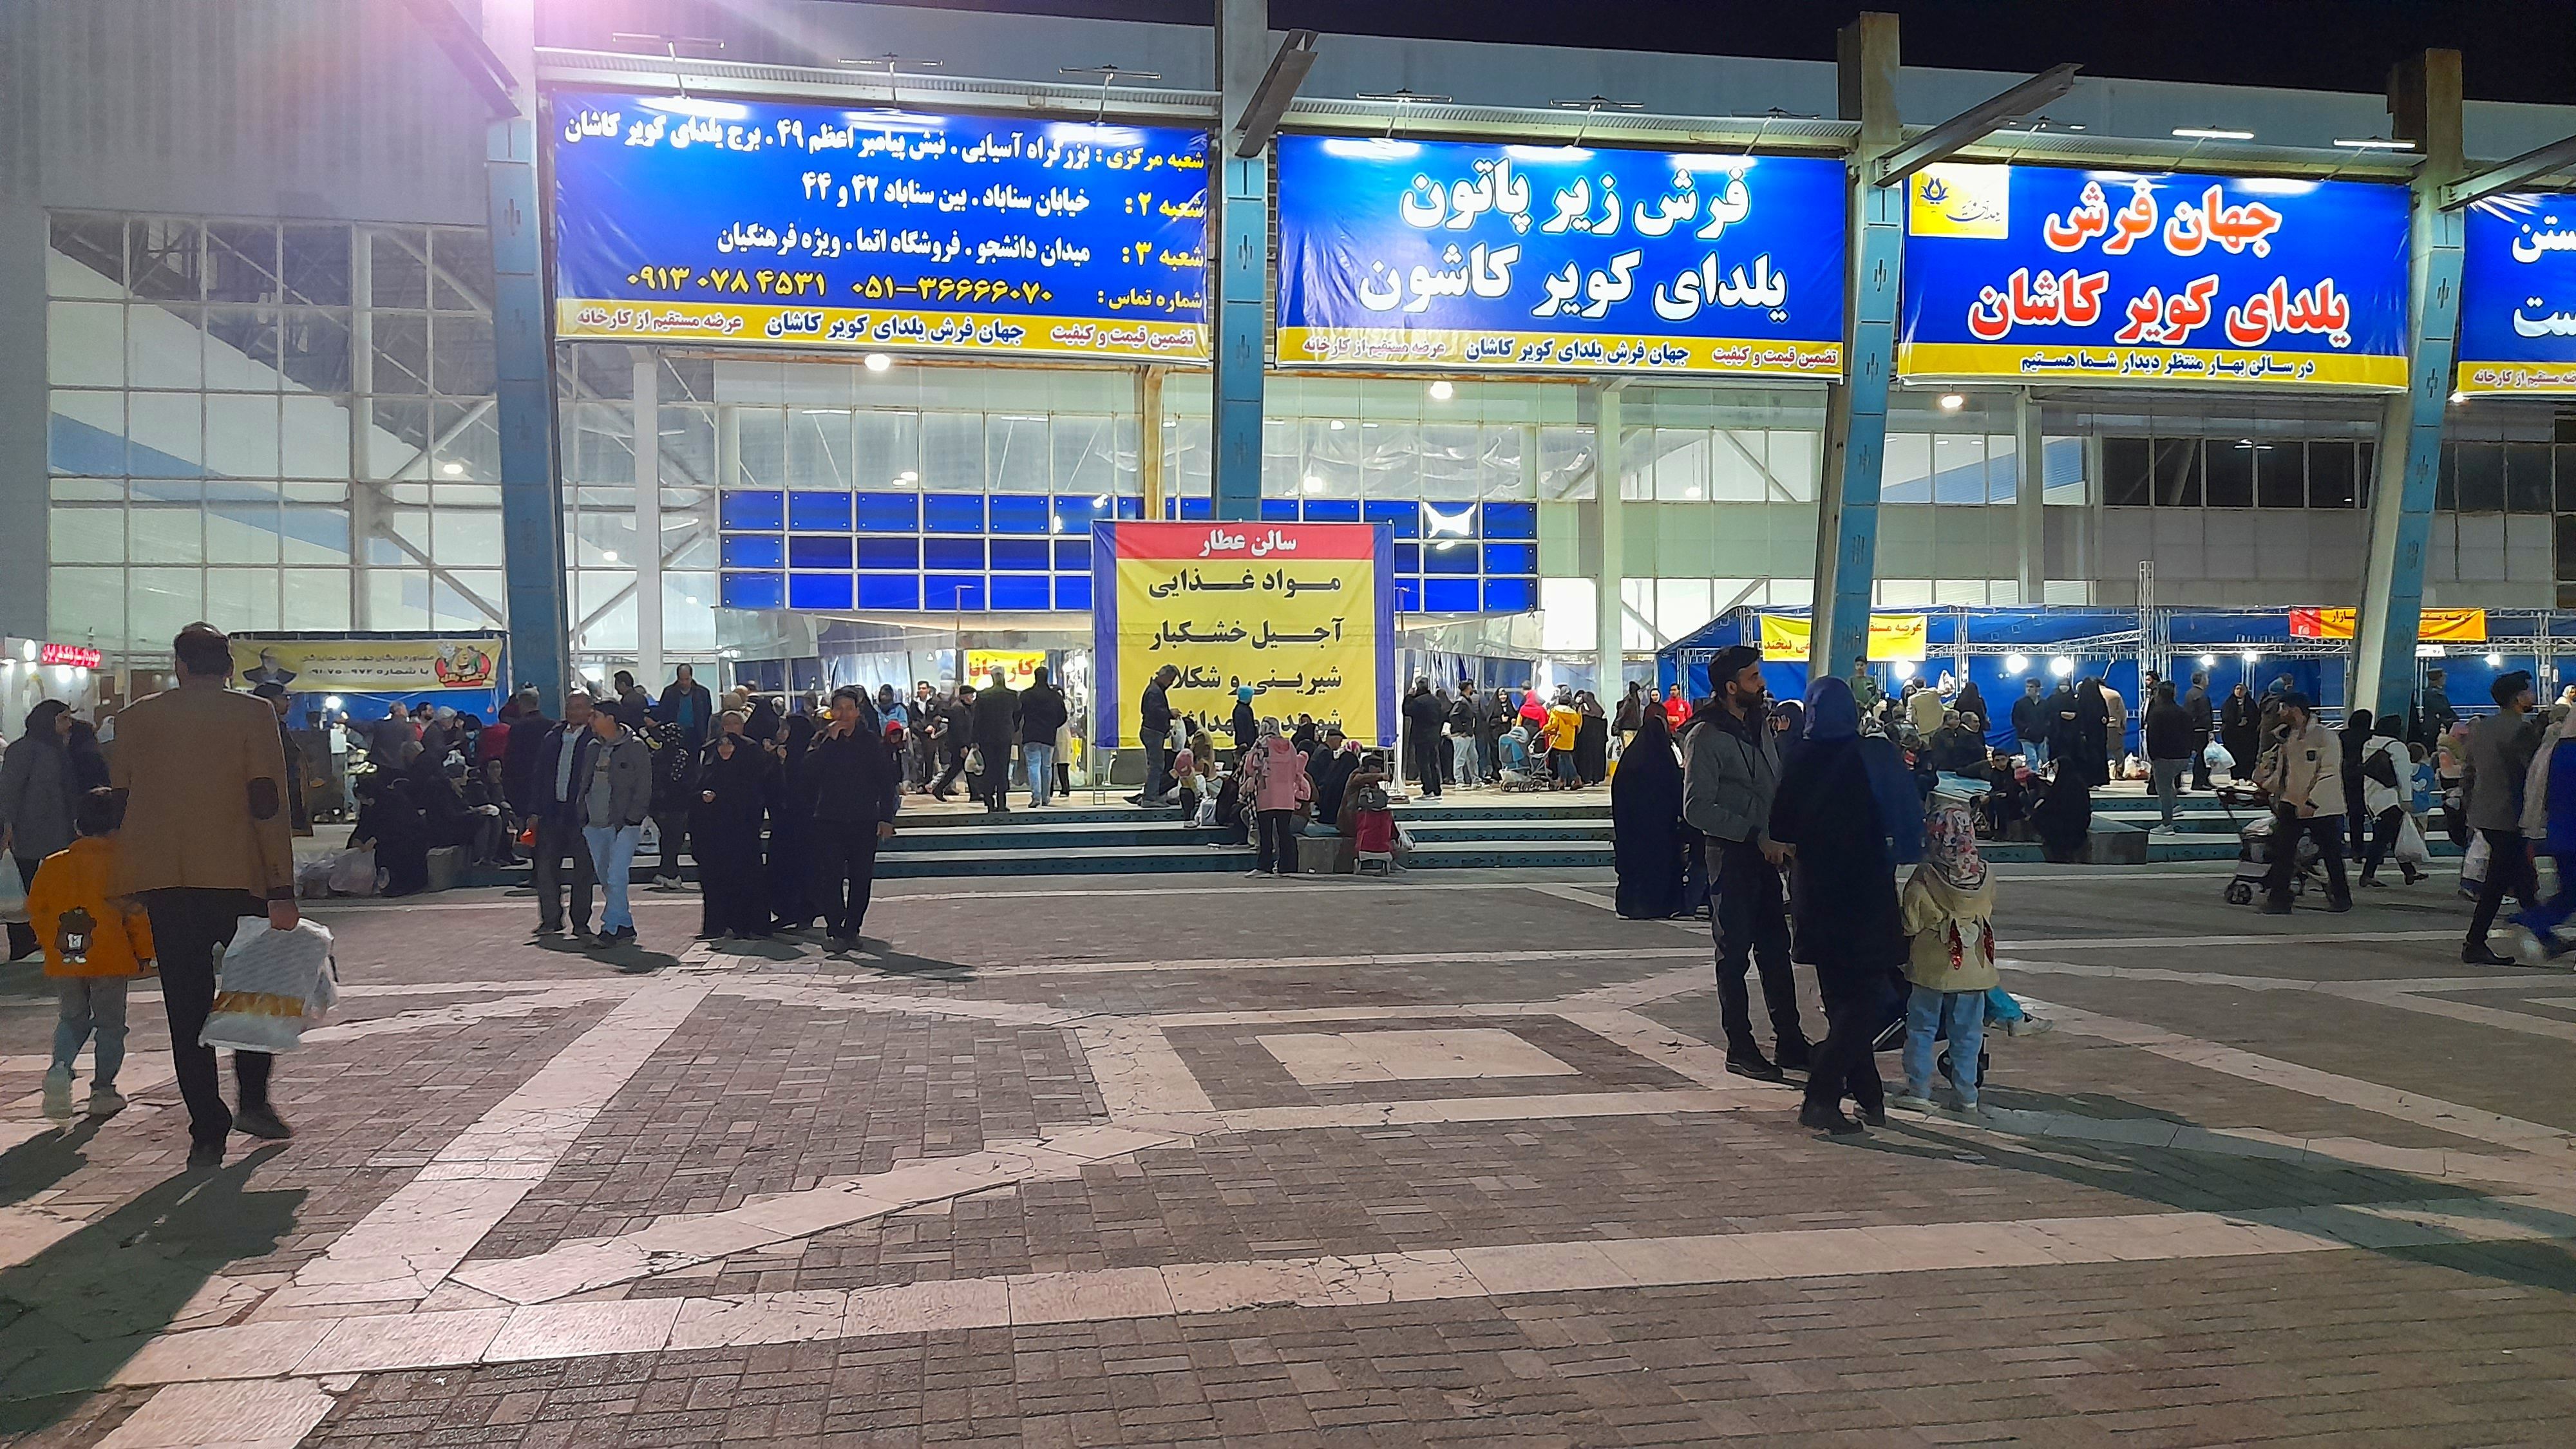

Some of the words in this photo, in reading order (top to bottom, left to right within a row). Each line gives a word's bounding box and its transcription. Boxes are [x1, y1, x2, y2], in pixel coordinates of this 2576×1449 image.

[565, 110, 621, 142] کاشان
[624, 114, 667, 147] کویر
[670, 115, 724, 149] یلدای
[726, 125, 761, 151] برج
[776, 118, 804, 148] ۴۹
[808, 123, 855, 155] اعظم
[858, 129, 905, 161] پیامبر
[909, 129, 946, 160] نبش
[961, 131, 1024, 163] آسیایی
[1026, 135, 1090, 170] بزرگراه
[1106, 147, 1163, 171] مرکزی
[1167, 151, 1205, 172] شعبه
[802, 171, 832, 200] ۴۴
[837, 185, 848, 207] و
[851, 174, 879, 203] ۴۲
[884, 178, 934, 209] سناباد
[1401, 158, 1531, 234] پاتون
[938, 189, 967, 213] بین
[982, 183, 1032, 214] سناباد
[1035, 186, 1090, 217] خیابان
[1138, 191, 1152, 216] ۲
[1159, 196, 1205, 222] شعبه
[1542, 173, 1622, 236] زیر
[1634, 166, 1751, 238] فرش
[2048, 180, 2155, 252] فرش
[2166, 185, 2280, 256] جهان
[717, 220, 798, 255] فرهنگیان
[801, 227, 840, 258] ویژه
[857, 227, 887, 252] اتما
[891, 229, 961, 263] فروشگاه
[975, 234, 1037, 265] دانشجو
[2512, 216, 2576, 263] ستن
[1041, 237, 1091, 267] میدان
[1135, 241, 1152, 265] ۳
[1159, 246, 1204, 271] شعبه
[1359, 243, 1519, 312] کاشون
[1533, 251, 1641, 318] کویر
[1653, 252, 1789, 322] یلدای
[1108, 289, 1151, 310] تماس
[1156, 291, 1203, 313] شماره
[1971, 270, 2108, 338] کاشان
[2116, 277, 2217, 345] کویر
[2227, 278, 2350, 346] یلدای
[577, 310, 631, 332] کارخانه
[636, 311, 649, 330] از
[653, 314, 699, 332] مستقیم
[703, 314, 743, 334] عرضه
[766, 312, 822, 337] کاشان
[828, 316, 869, 339] کویر
[873, 315, 925, 342] یلدای
[929, 317, 973, 343] فرش
[978, 319, 1024, 345] جهان
[1051, 325, 1095, 343] کیفیت
[1097, 330, 1106, 346] و
[1110, 328, 1146, 345] قیمت
[1150, 330, 1195, 349] تضمین
[1303, 337, 1350, 356] کارخانه
[1354, 338, 1365, 357] از
[1368, 341, 1408, 357] مستقیم
[1412, 342, 1445, 359] عرضه
[1466, 337, 1514, 361] کاشان
[1517, 340, 1553, 362] کویر
[1558, 341, 1602, 364] یلدای
[1607, 341, 1645, 365] فرش
[1649, 343, 1689, 366] جهان
[1712, 346, 1749, 364] کیفیت
[1754, 352, 1760, 366] و
[1763, 348, 1795, 367] قیمت
[1798, 350, 1836, 368] تضمین
[2022, 354, 2076, 372] هستیم
[2080, 352, 2116, 370] شما
[2122, 354, 2159, 374] دیدار
[2164, 354, 2204, 375] منتظر
[2208, 355, 2244, 377] بهار
[2249, 356, 2293, 375] سالن
[2298, 360, 2314, 377] در
[2474, 370, 2512, 386] کارخانه
[2516, 372, 2524, 386] از
[2528, 372, 2559, 385] مستقیم
[1199, 529, 1245, 556] عطار
[1251, 530, 1296, 556] سالن
[1149, 568, 1255, 598] غذایی
[1262, 569, 1341, 598] مواد
[1150, 621, 1247, 650] خشکبار
[1252, 618, 1344, 649] آجیل
[376, 667, 416, 676] شماره
[1150, 665, 1221, 688] شکلا
[1248, 667, 1341, 695] شیرینی
